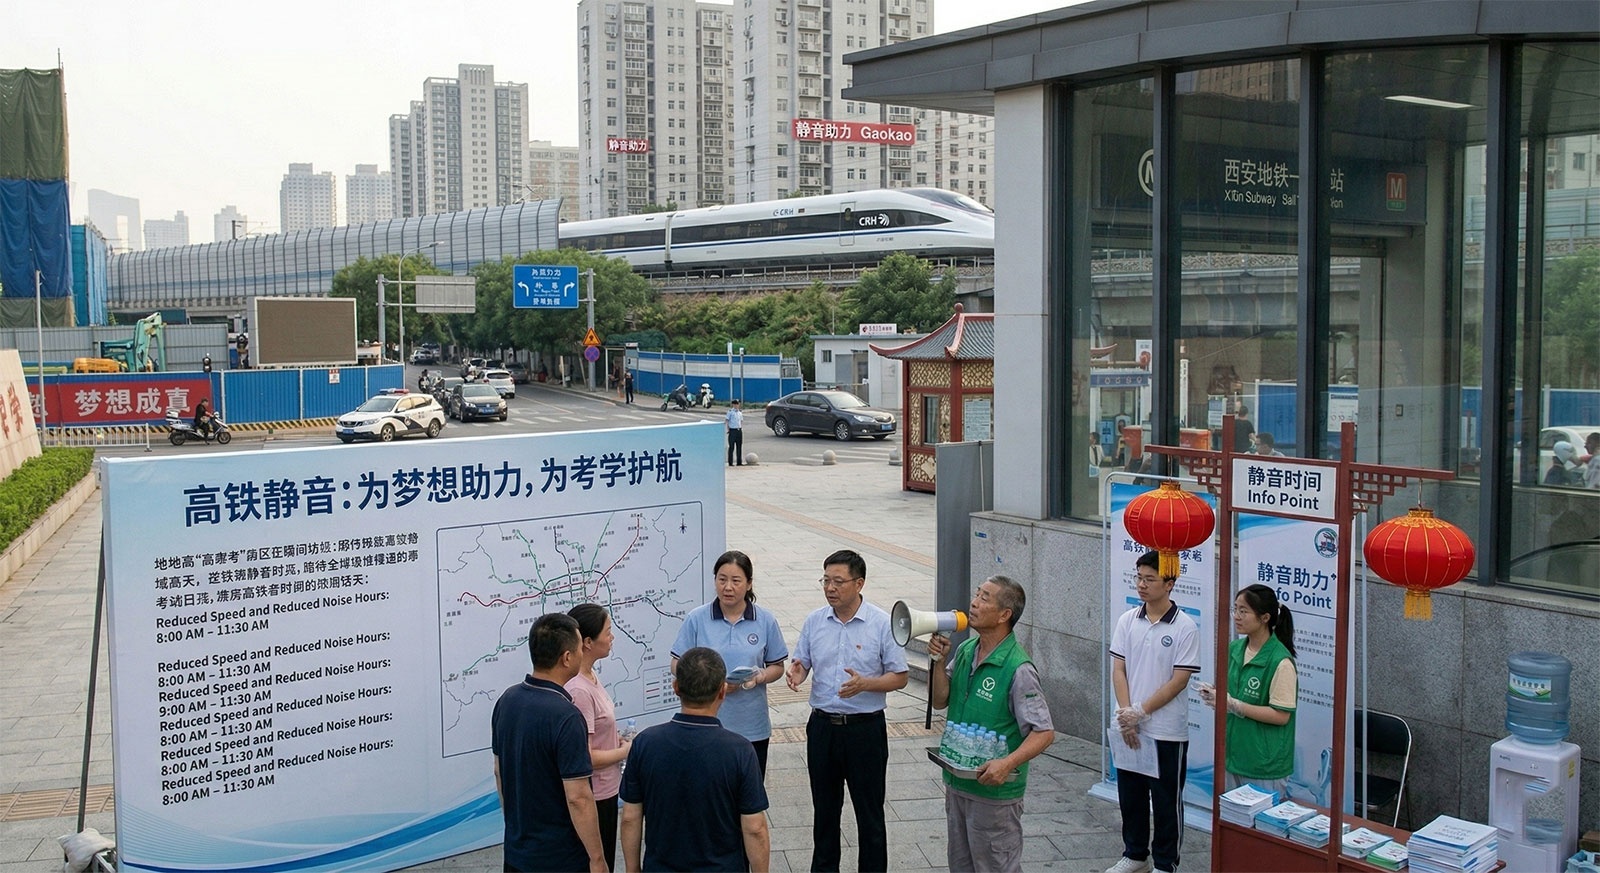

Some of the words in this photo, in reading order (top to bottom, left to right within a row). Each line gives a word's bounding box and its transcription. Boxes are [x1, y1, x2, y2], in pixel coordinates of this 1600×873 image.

[608, 139, 647, 151] 静音助力
[796, 121, 851, 139] 静音助力
[861, 127, 912, 141] Gaokao
[1245, 191, 1276, 207] Subway
[859, 217, 877, 226] CRH
[75, 387, 190, 416] 梦想成真
[1248, 466, 1321, 492] 静音时间
[1248, 490, 1275, 504] Info
[1280, 493, 1319, 510] Point
[1257, 562, 1328, 591] 静音助力
[156, 612, 207, 628] Reduced
[211, 607, 246, 623] Speed
[249, 604, 270, 617] and
[273, 598, 320, 614] Reduced
[323, 595, 352, 607] Noise
[355, 592, 389, 603] Hours:
[1276, 587, 1289, 602] fo
[1294, 591, 1331, 609] Point
[157, 630, 183, 643] 8:00
[185, 628, 204, 640] AM
[217, 622, 248, 636] 11:30
[251, 619, 269, 631] AM
[158, 655, 209, 673] Reduced
[212, 650, 247, 667] Speed
[250, 646, 271, 660] and
[275, 639, 321, 656] Reduced
[324, 636, 353, 649] Noise
[356, 632, 390, 644] Hours:
[158, 674, 184, 688] 8:00
[187, 671, 205, 683] AM
[219, 664, 250, 679] 11:30
[253, 661, 270, 674] AM
[159, 684, 209, 702] Reduced
[213, 678, 248, 696] Speed
[251, 675, 272, 688] and
[276, 667, 322, 684] Reduced
[325, 664, 354, 676] Noise
[357, 659, 391, 671] Hours:
[159, 703, 185, 717] 9:00
[188, 700, 206, 712] AM
[220, 693, 251, 707] 11:30
[254, 690, 271, 702] AM
[160, 713, 210, 732] Reduced
[214, 707, 249, 724] Speed
[252, 703, 273, 716] and
[276, 695, 323, 712] Reduced
[326, 691, 355, 704] Noise
[358, 686, 391, 698] Hours:
[160, 733, 186, 747] 8:00
[189, 729, 207, 742] AM
[221, 722, 252, 736] 11:30
[255, 718, 272, 730] AM
[161, 742, 211, 761] Reduced
[215, 735, 250, 753] Speed
[253, 731, 274, 745] and
[277, 722, 323, 741] Reduced
[327, 718, 356, 731] Noise
[359, 713, 392, 726] Hours:
[161, 762, 187, 776] 8:00
[190, 758, 208, 771] AM
[222, 750, 253, 765] 11:30
[256, 746, 273, 759] AM
[162, 771, 212, 791] Reduced
[216, 764, 251, 782] Speed
[254, 759, 274, 773] and
[278, 750, 324, 769] Reduced
[327, 746, 357, 759] Noise
[359, 740, 393, 753] Hours:
[162, 791, 188, 806] 8:00
[191, 787, 210, 800] AM
[223, 778, 254, 794] 11:30
[257, 774, 274, 787] AM
